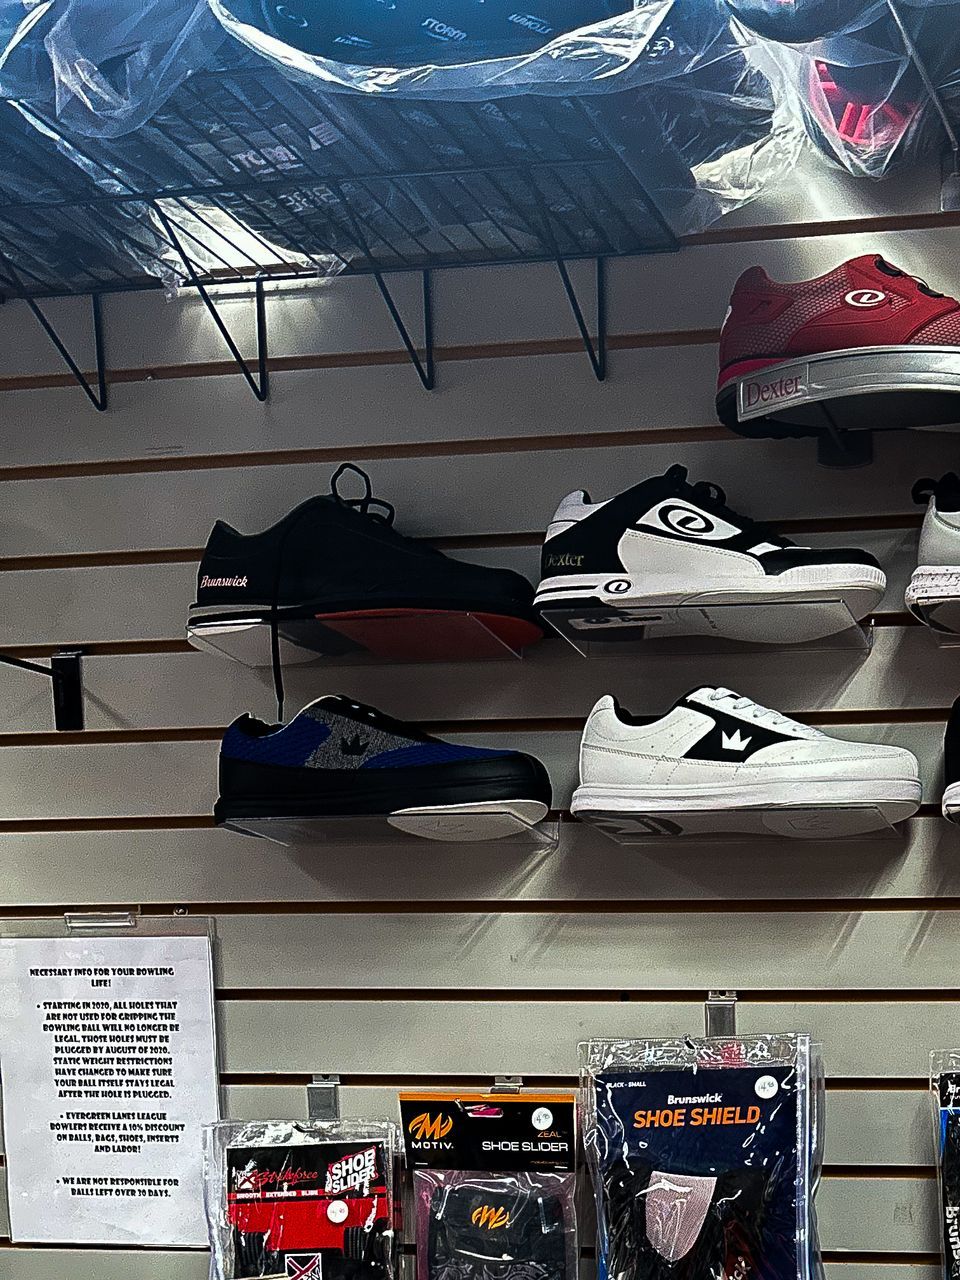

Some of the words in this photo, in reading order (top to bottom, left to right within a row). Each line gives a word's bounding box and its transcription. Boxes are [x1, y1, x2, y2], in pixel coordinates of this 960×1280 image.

[421, 17, 467, 41] STORM
[746, 376, 801, 407] Dexter
[200, 575, 248, 588] Brunswick
[30, 967, 73, 977] NECESSARY
[74, 967, 93, 977] INFO
[94, 967, 110, 977] FOR
[111, 967, 135, 977] YOUR
[136, 967, 174, 977] BOWLING
[91, 979, 111, 988] LIFE!
[43, 1001, 81, 1011] STARTING
[82, 1001, 90, 1011] IN
[113, 1001, 127, 1011] ALL
[129, 1001, 154, 1011] HOLES
[155, 1001, 177, 1011] THAT
[46, 1013, 61, 1021] ARE
[62, 1013, 77, 1021] NOT
[79, 1013, 99, 1021] USED
[101, 1013, 117, 1021] FOR
[119, 1013, 158, 1021] GRIPPING
[159, 1013, 175, 1021] THE
[43, 1024, 80, 1032] BOWLING
[82, 1024, 101, 1032] BALL
[102, 1024, 123, 1032] WILL
[124, 1024, 135, 1032] NO
[137, 1024, 168, 1032] LONGER
[169, 1024, 179, 1032] BE
[81, 1035, 107, 1043] THOSE
[109, 1035, 134, 1043] HOLES
[136, 1035, 157, 1043] MUST
[159, 1035, 169, 1043] BE
[54, 1046, 91, 1054] PLUGGED
[93, 1046, 103, 1054] BY
[105, 1046, 136, 1054] AUGUST
[138, 1046, 148, 1054] OF
[53, 1057, 80, 1066] STATIC
[82, 1057, 114, 1066] WEIGHT
[116, 1057, 173, 1066] RESTRICTIONS
[55, 1068, 76, 1077] HAVE
[78, 1068, 114, 1077] CHANGED
[116, 1068, 126, 1077] TO
[128, 1068, 150, 1077] MAKE
[152, 1068, 172, 1077] SURE
[54, 1079, 77, 1088] YOUR
[78, 1079, 96, 1088] BALL
[98, 1079, 124, 1088] ITSELF
[125, 1079, 149, 1088] STAYS
[151, 1079, 175, 1088] LEGAL
[58, 1090, 82, 1099] AFTER
[84, 1090, 100, 1099] THE
[101, 1090, 122, 1099] HOLE
[124, 1090, 131, 1099] IS
[133, 1090, 172, 1099] PLUGGED.
[667, 1093, 722, 1105] Brunswick
[66, 1112, 111, 1121] EVERGREEN
[112, 1112, 135, 1121] LANES
[137, 1112, 167, 1121] LEAGUE
[633, 1108, 686, 1128] SHOE
[689, 1106, 760, 1126] SHIELD
[50, 1123, 87, 1132] BOWLERS
[89, 1123, 120, 1132] RECEIVE
[122, 1123, 127, 1132] A
[145, 1123, 185, 1132] DISCOUNT
[57, 1134, 67, 1143] ON
[68, 1134, 94, 1143] BALLS,
[95, 1134, 117, 1143] BAGS,
[119, 1134, 146, 1143] SHOES,
[147, 1134, 179, 1143] INSERTS
[537, 1130, 562, 1138] ZEAL
[94, 1145, 111, 1154] AND
[112, 1145, 141, 1154] LABOR!
[411, 1141, 454, 1150] MOTIV
[482, 1141, 520, 1151] SHOE
[522, 1142, 568, 1152] SLIDER
[332, 1148, 376, 1181] SHOE
[62, 1177, 74, 1187] WE
[76, 1177, 91, 1187] ARE
[93, 1177, 108, 1187] NOT
[110, 1177, 162, 1187] RESPONSIBLE
[163, 1177, 179, 1187] FOR
[332, 1166, 376, 1194] SLIDER
[71, 1188, 94, 1198] BALLS
[95, 1188, 113, 1198] LEFT
[115, 1188, 136, 1198] OVER
[148, 1188, 171, 1198] DAYS.
